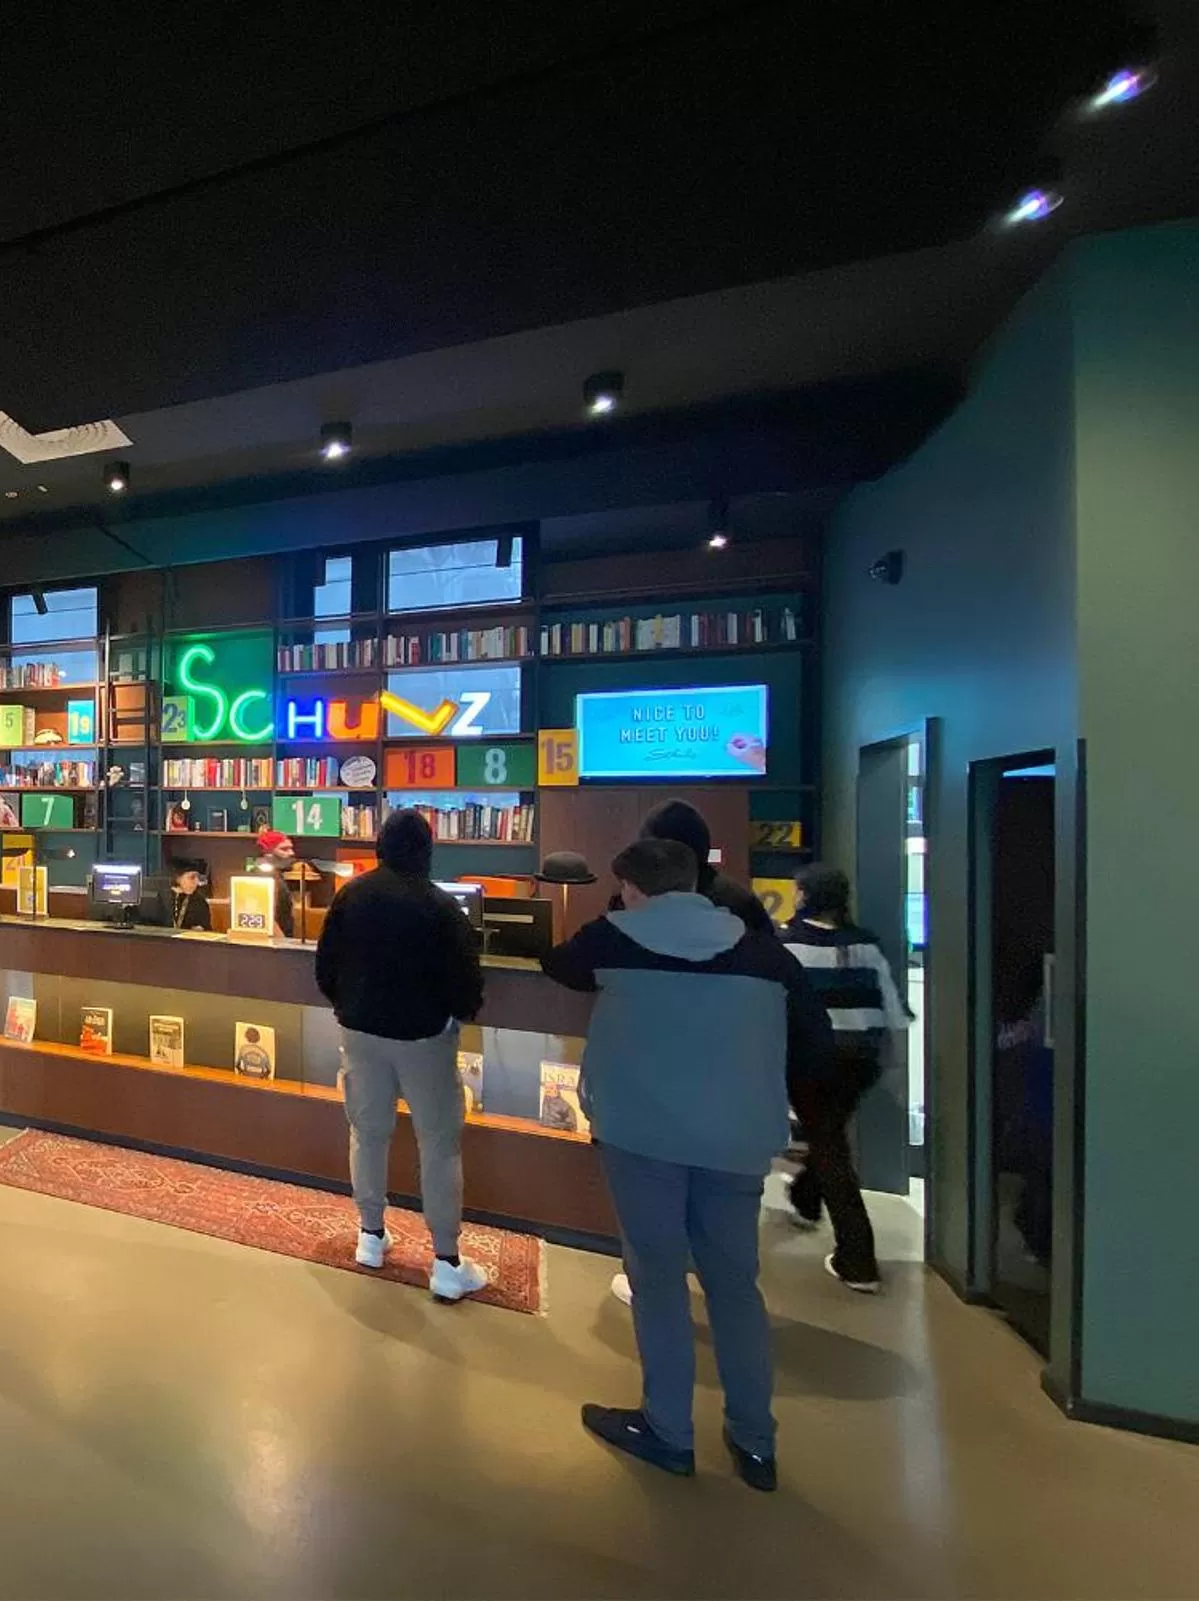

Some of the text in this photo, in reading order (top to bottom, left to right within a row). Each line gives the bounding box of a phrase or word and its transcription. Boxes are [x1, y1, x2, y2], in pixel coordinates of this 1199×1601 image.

[5, 713, 13, 728] 5
[71, 712, 90, 736] 19
[161, 703, 186, 733] 23
[632, 704, 705, 722] NICE TO
[620, 726, 719, 743] MEET YOU!
[404, 750, 435, 784] 18
[484, 748, 507, 785] 8
[541, 737, 574, 774] 15
[41, 797, 55, 826] 7
[292, 800, 322, 834] 14
